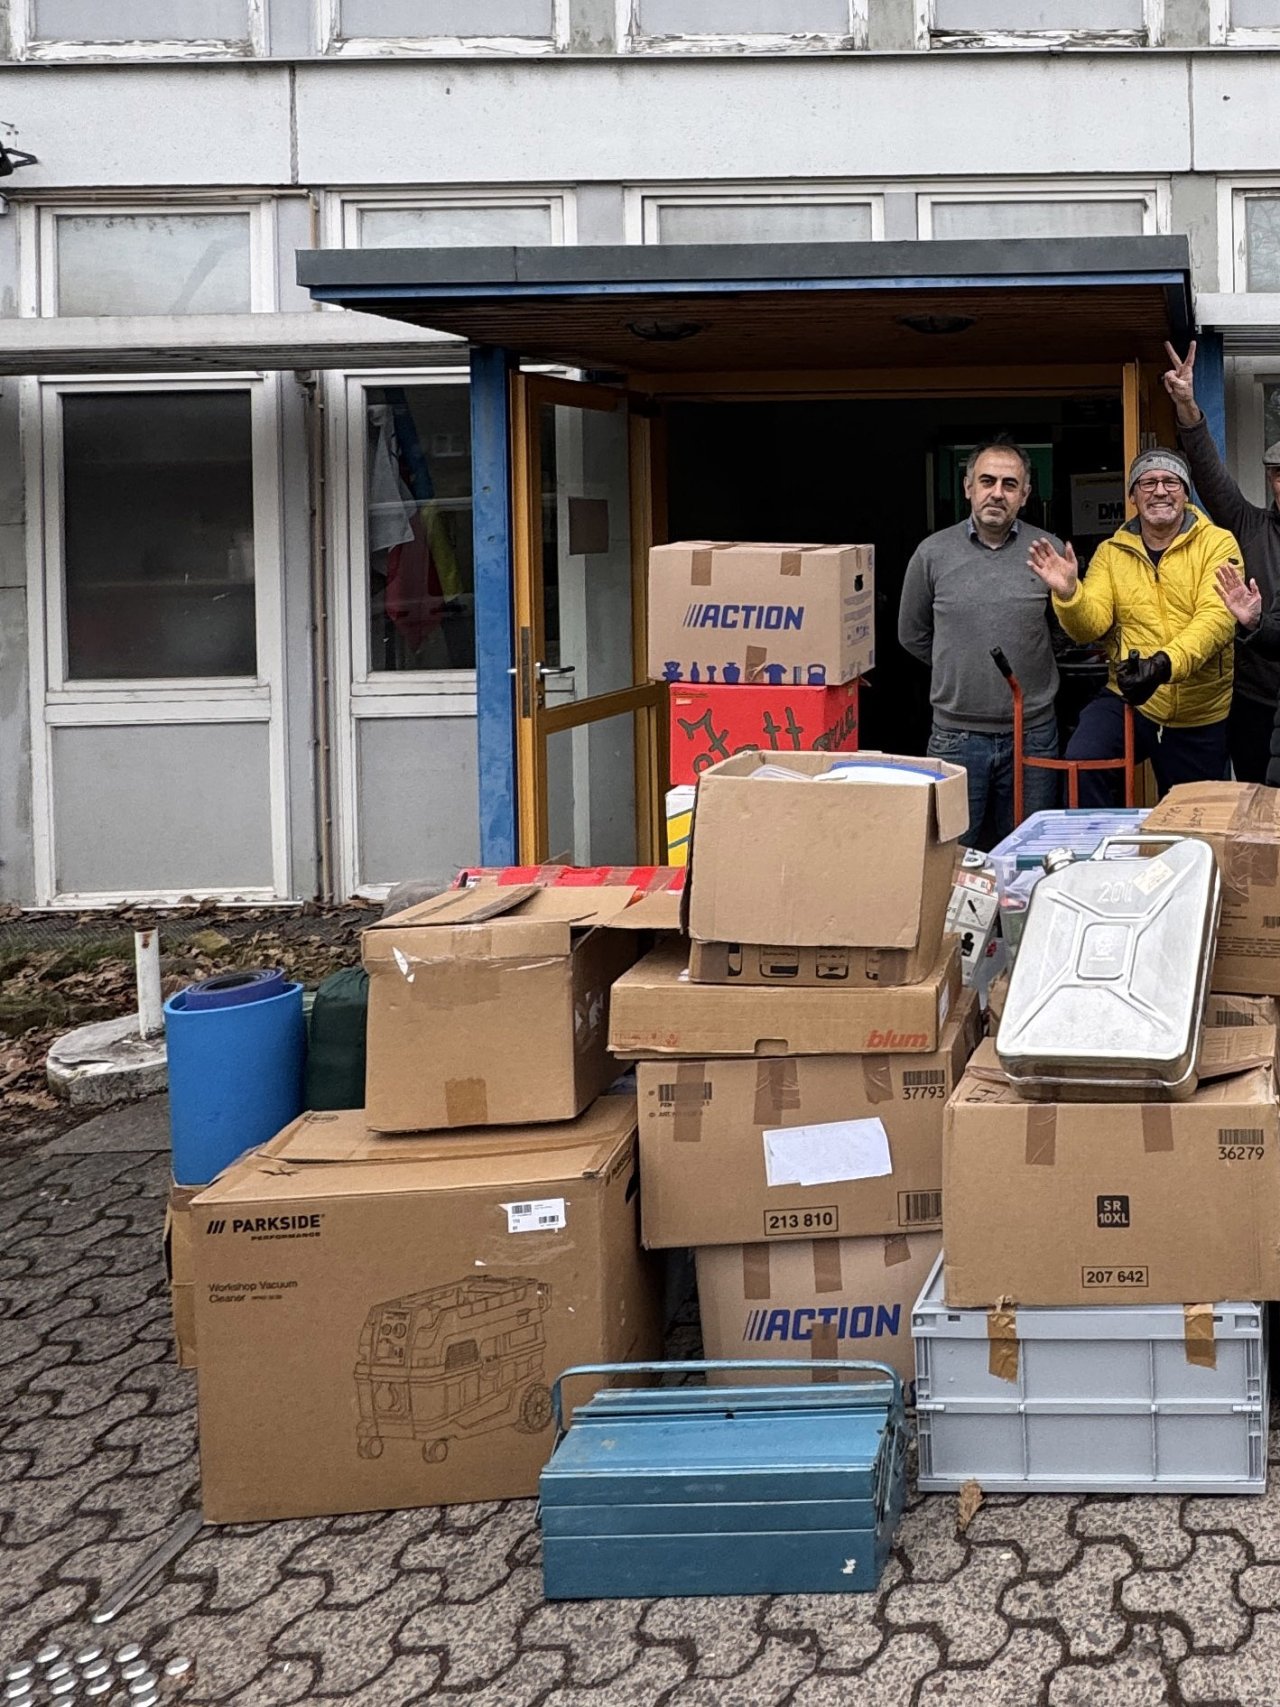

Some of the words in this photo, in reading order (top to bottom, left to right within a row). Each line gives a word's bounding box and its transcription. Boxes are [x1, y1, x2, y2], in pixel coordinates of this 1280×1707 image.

[700, 604, 804, 630] ACTION
[866, 1029, 928, 1048] blum
[902, 1086, 945, 1100] 37793
[1218, 1147, 1265, 1160] 36279
[232, 1214, 321, 1233] PARKSIDE
[770, 1215, 799, 1229] 213
[803, 1212, 833, 1227] 810
[1098, 1213, 1128, 1224] 10XL
[251, 1232, 321, 1241] PERFORMANCE
[1086, 1271, 1113, 1283] 207
[1117, 1270, 1144, 1283] 642
[208, 1282, 257, 1292] Workshop
[259, 1281, 298, 1289] Vacuum
[208, 1294, 246, 1303] Cleaner
[763, 1304, 901, 1341] ACTION
